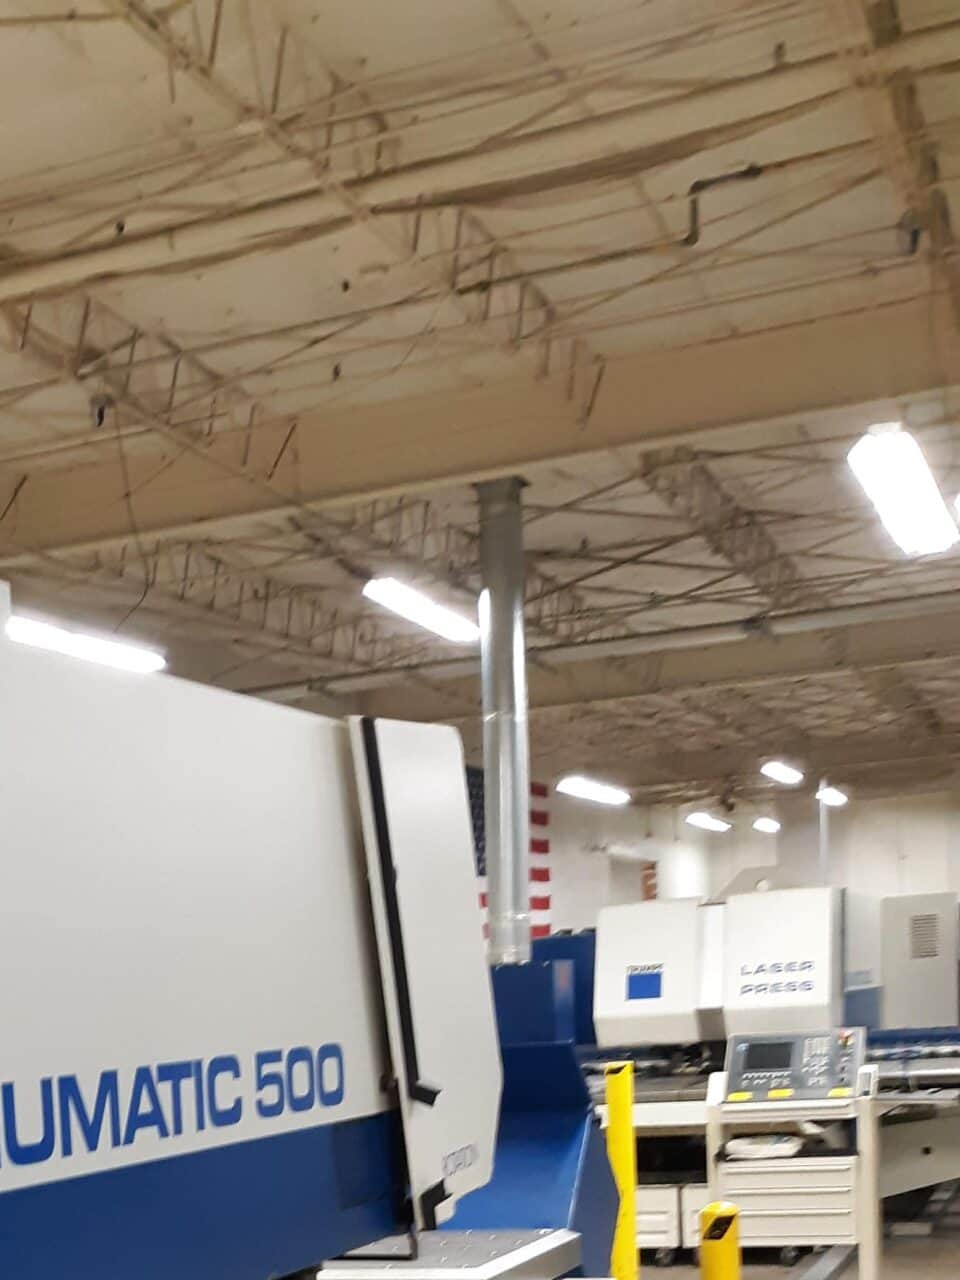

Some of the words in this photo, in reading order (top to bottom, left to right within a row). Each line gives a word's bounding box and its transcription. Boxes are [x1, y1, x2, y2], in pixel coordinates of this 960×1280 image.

[740, 961, 815, 976] LASER
[740, 980, 814, 995] PRESS
[255, 1042, 344, 1118] 500
